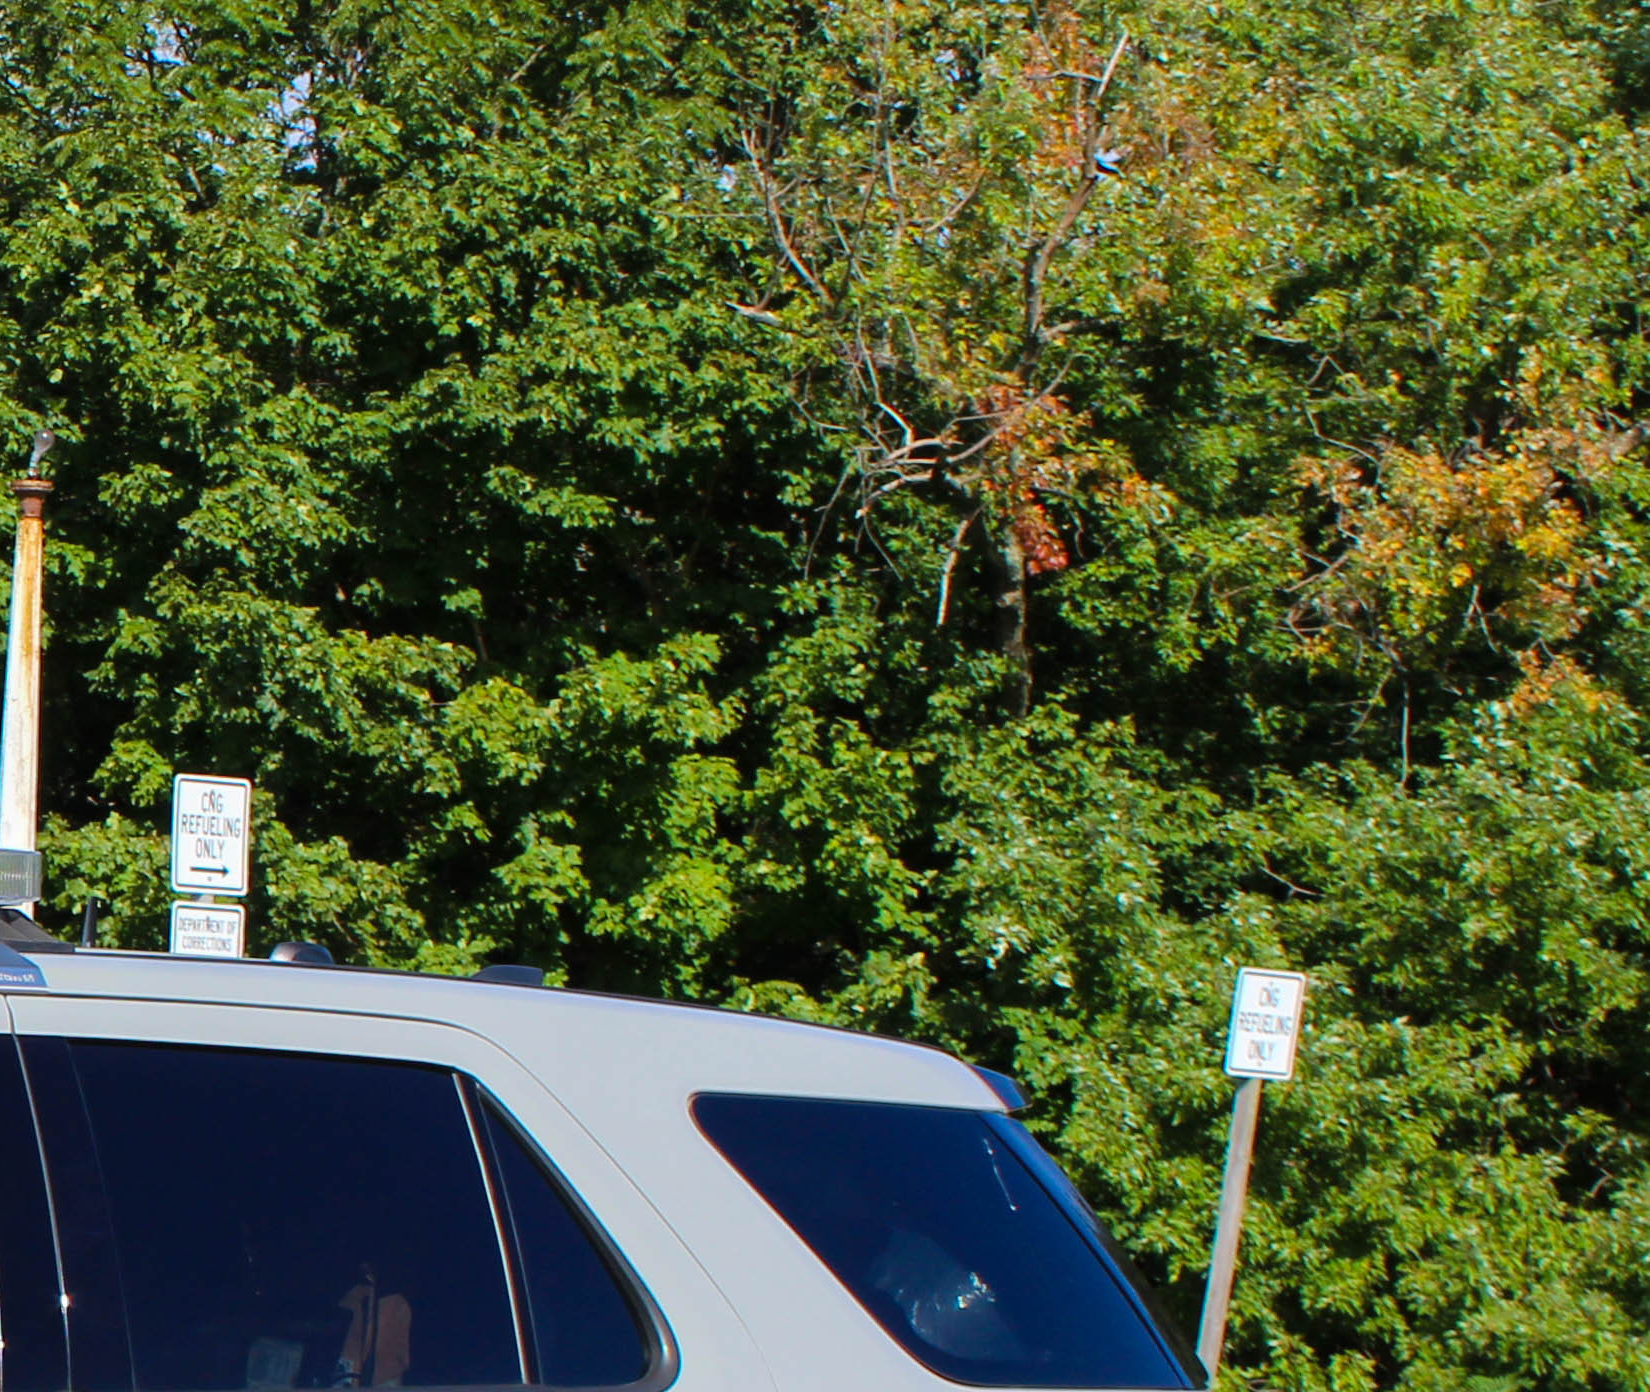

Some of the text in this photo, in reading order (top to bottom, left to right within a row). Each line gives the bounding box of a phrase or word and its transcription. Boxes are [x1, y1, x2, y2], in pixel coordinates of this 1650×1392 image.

[201, 792, 223, 813] CNG
[181, 814, 241, 838] REFUELING
[195, 837, 225, 859] ONLY
[178, 917, 237, 935] DEPARTMENT OF
